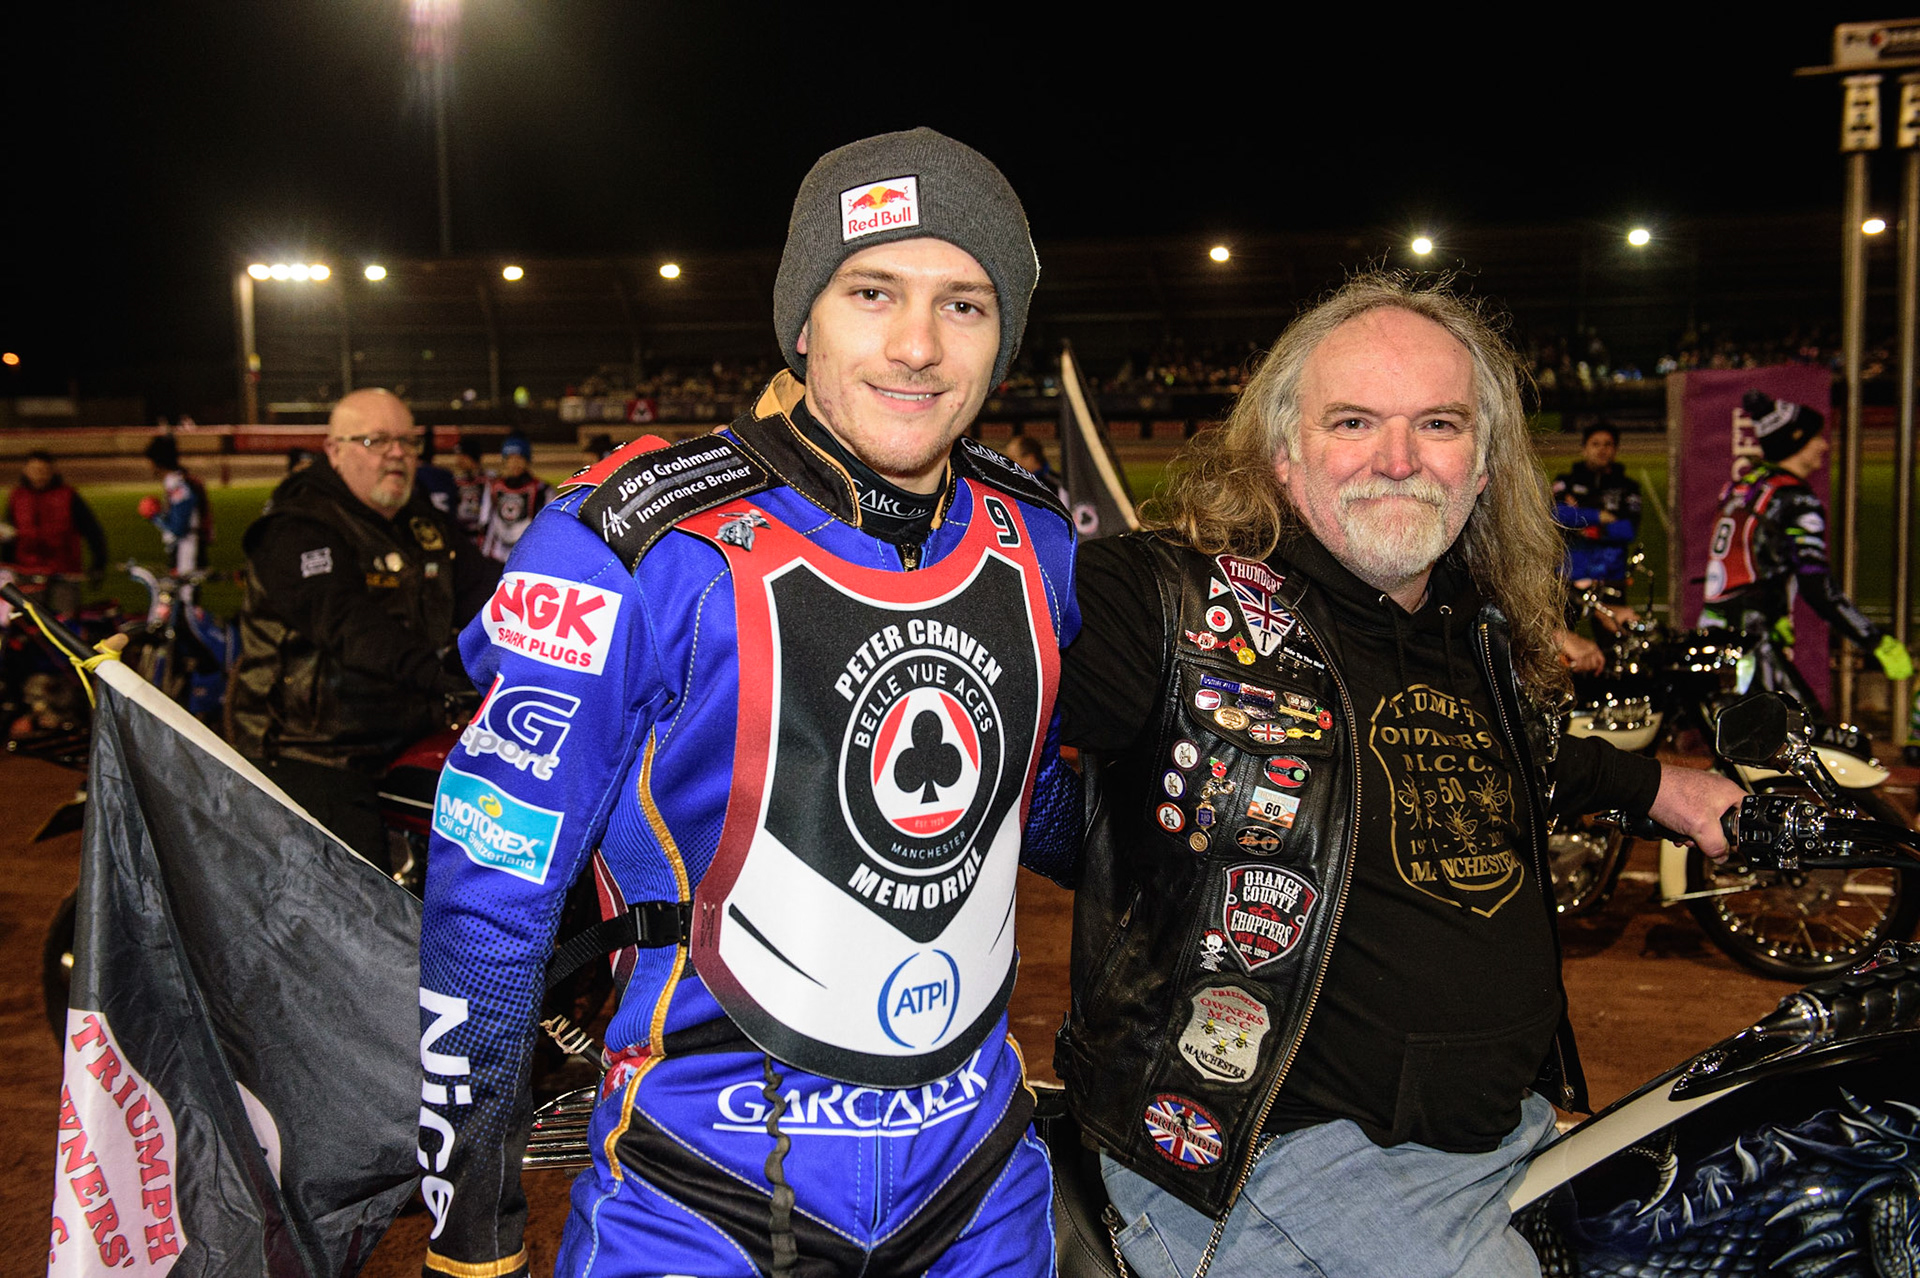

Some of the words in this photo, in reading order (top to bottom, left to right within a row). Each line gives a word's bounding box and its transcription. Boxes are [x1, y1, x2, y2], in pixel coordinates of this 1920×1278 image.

[848, 212, 879, 234] Red
[881, 206, 912, 226] Bull
[617, 469, 655, 502] Jörg
[652, 445, 732, 476] Grohmann
[636, 480, 707, 524] Insurance
[705, 465, 751, 488] Broker
[984, 495, 1021, 547] 9
[490, 578, 606, 647] NGK
[498, 627, 526, 650] SPARK
[528, 637, 592, 668] PLUGS
[834, 624, 905, 702] PETER
[907, 619, 1003, 687] CRAVEN
[854, 674, 902, 749] BELLE
[907, 663, 948, 685] VUE
[954, 678, 993, 734] ACES
[459, 725, 560, 780] sport
[1264, 801, 1282, 817] 60
[1437, 777, 1467, 804] 50
[439, 814, 454, 831] Oil
[454, 826, 468, 838] of
[468, 831, 536, 870] Switzerland
[440, 793, 540, 858] MOTOREX
[891, 830, 967, 860] MANCHESTER
[847, 846, 983, 911] MEMORIAL
[1244, 870, 1303, 900] ORANGE
[1410, 849, 1521, 882] MNCHESTER
[1242, 886, 1297, 914] COUNTY
[1231, 909, 1293, 948] CHOPPERS
[1234, 931, 1255, 945] NEW
[1256, 935, 1280, 953] YORK
[1239, 943, 1253, 954] EST.
[1253, 947, 1270, 959] 1999
[894, 979, 948, 1018] ATPI
[1200, 997, 1265, 1026] OWNERS
[1210, 989, 1264, 1013] TRIUMPH
[1183, 1043, 1247, 1079] MANCHESTER
[71, 1014, 180, 1266] TRIUMPH
[59, 1084, 135, 1269] WNERS'
